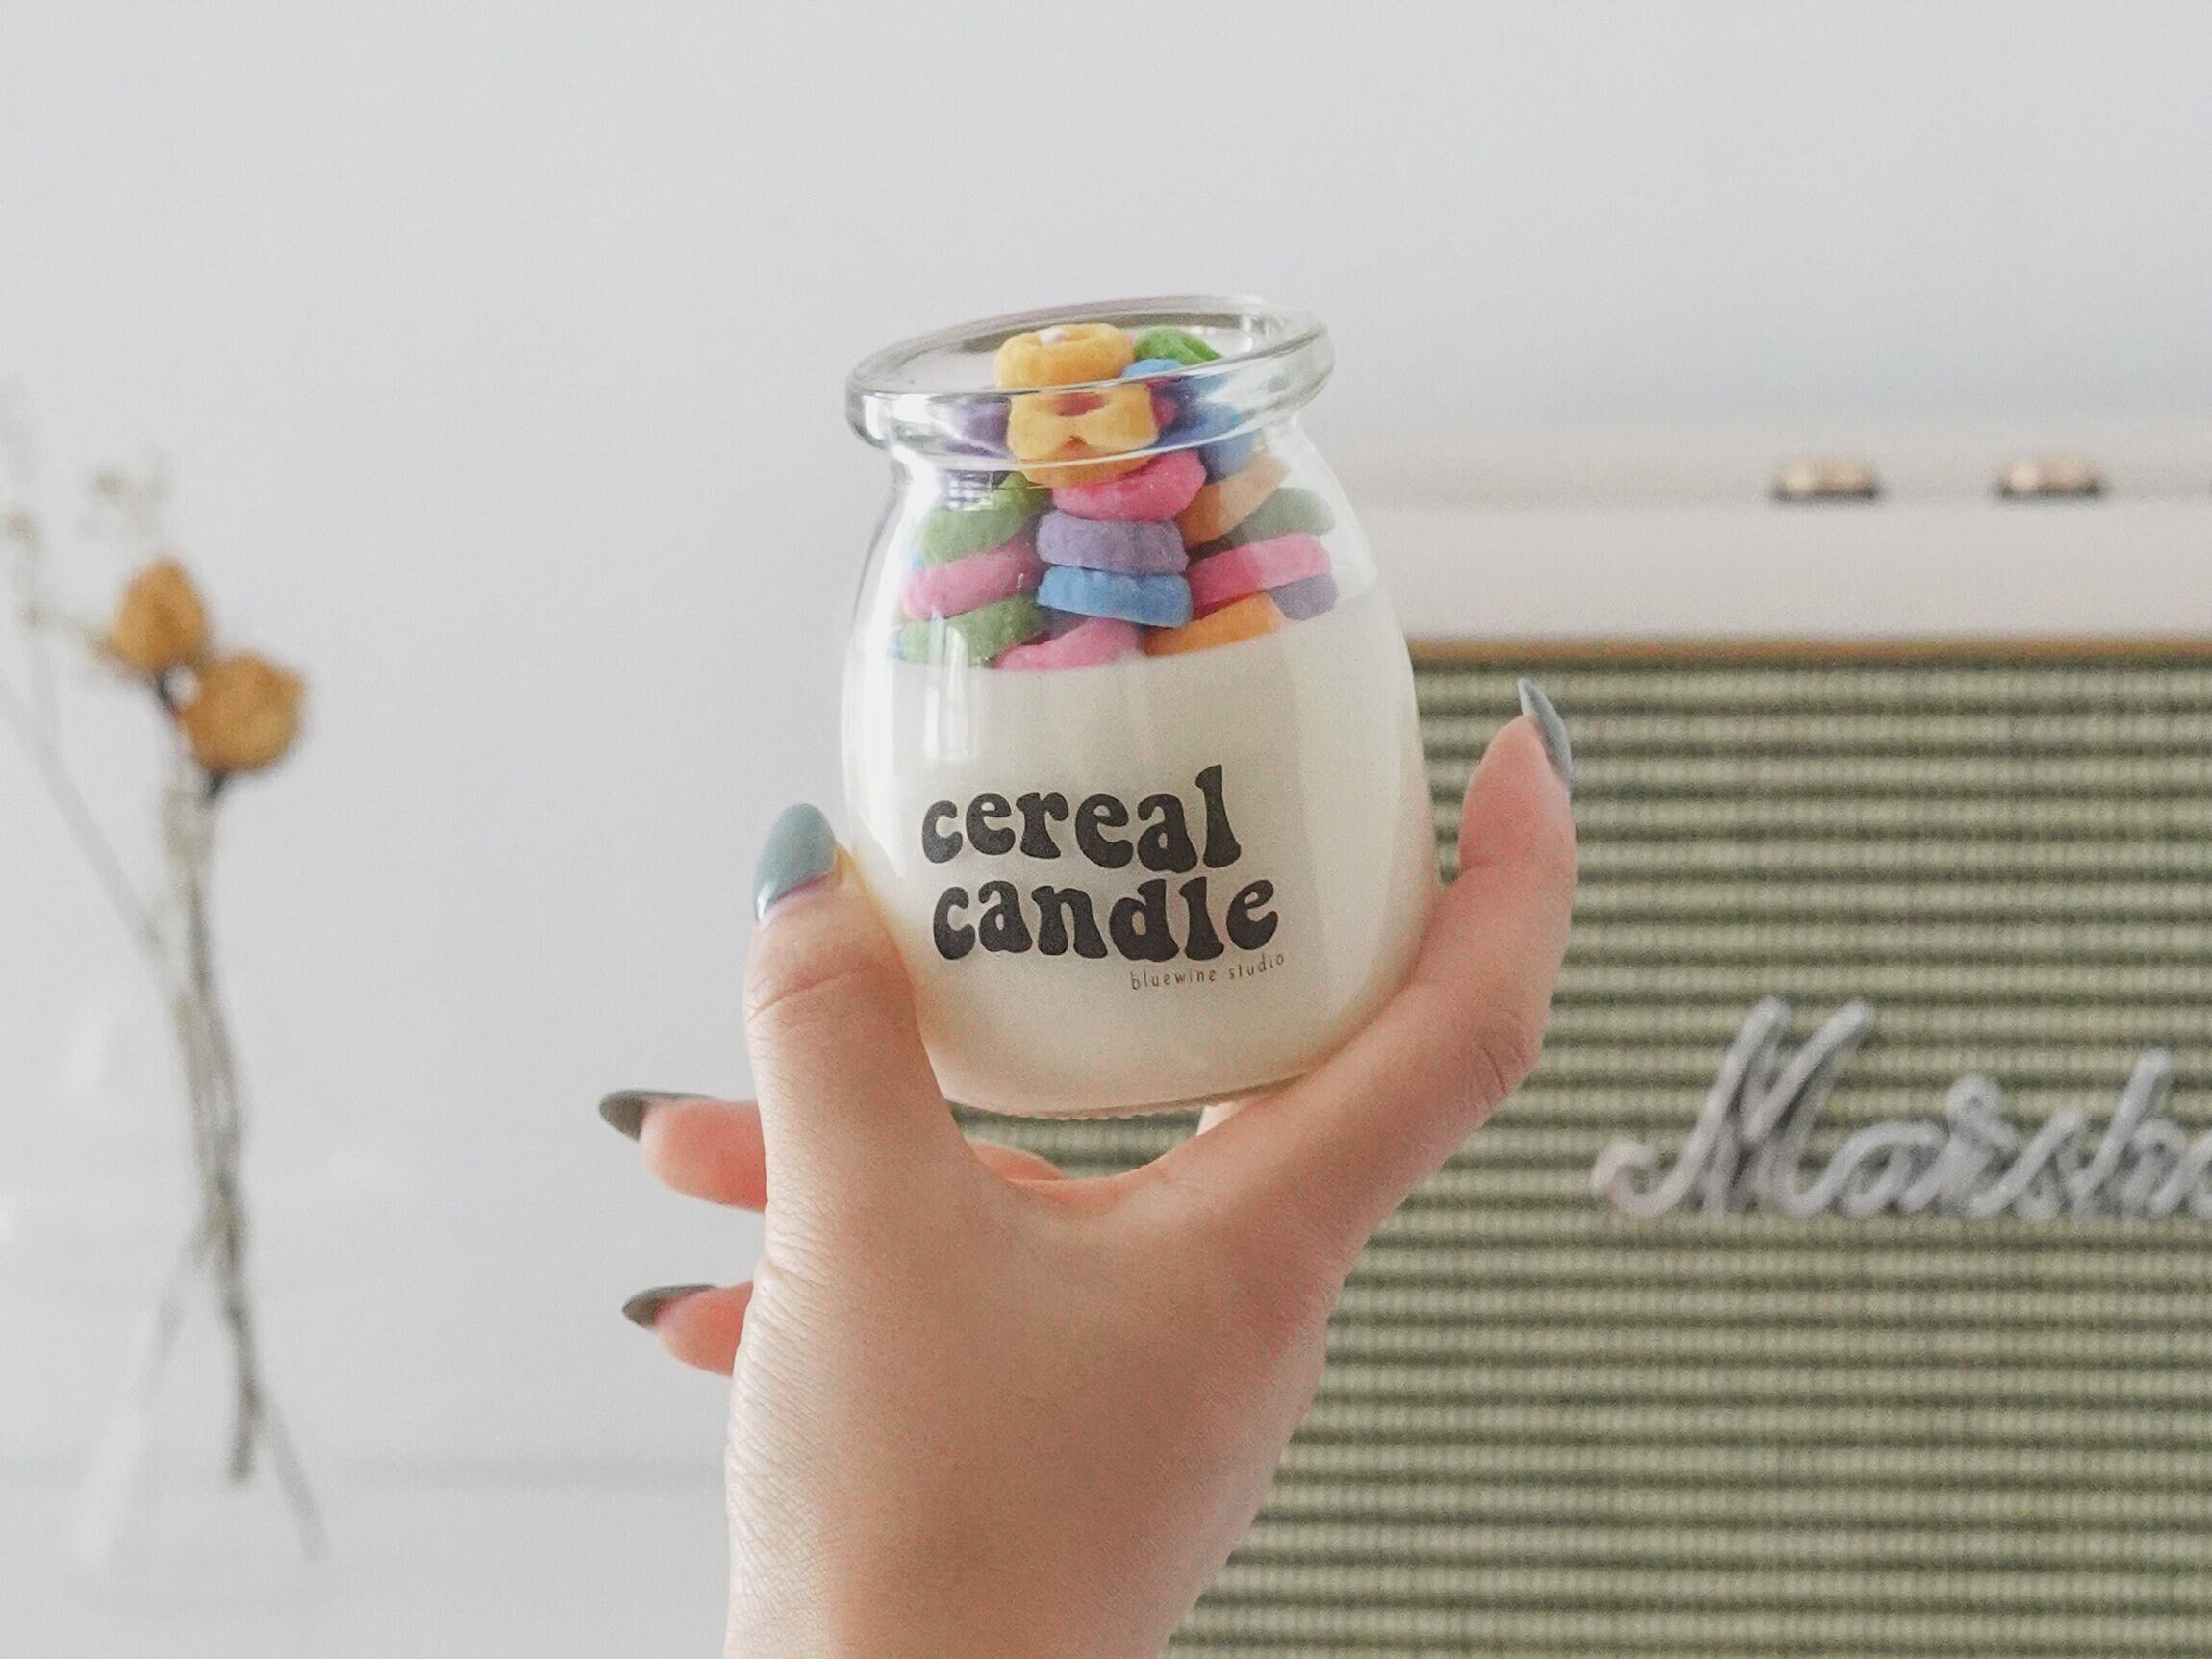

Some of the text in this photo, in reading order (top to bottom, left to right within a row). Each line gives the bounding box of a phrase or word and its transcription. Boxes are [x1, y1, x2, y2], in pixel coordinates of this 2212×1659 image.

[922, 765, 1241, 873] cereal
[933, 876, 1278, 962] candle
[1130, 952, 1285, 991] bluewine studio
